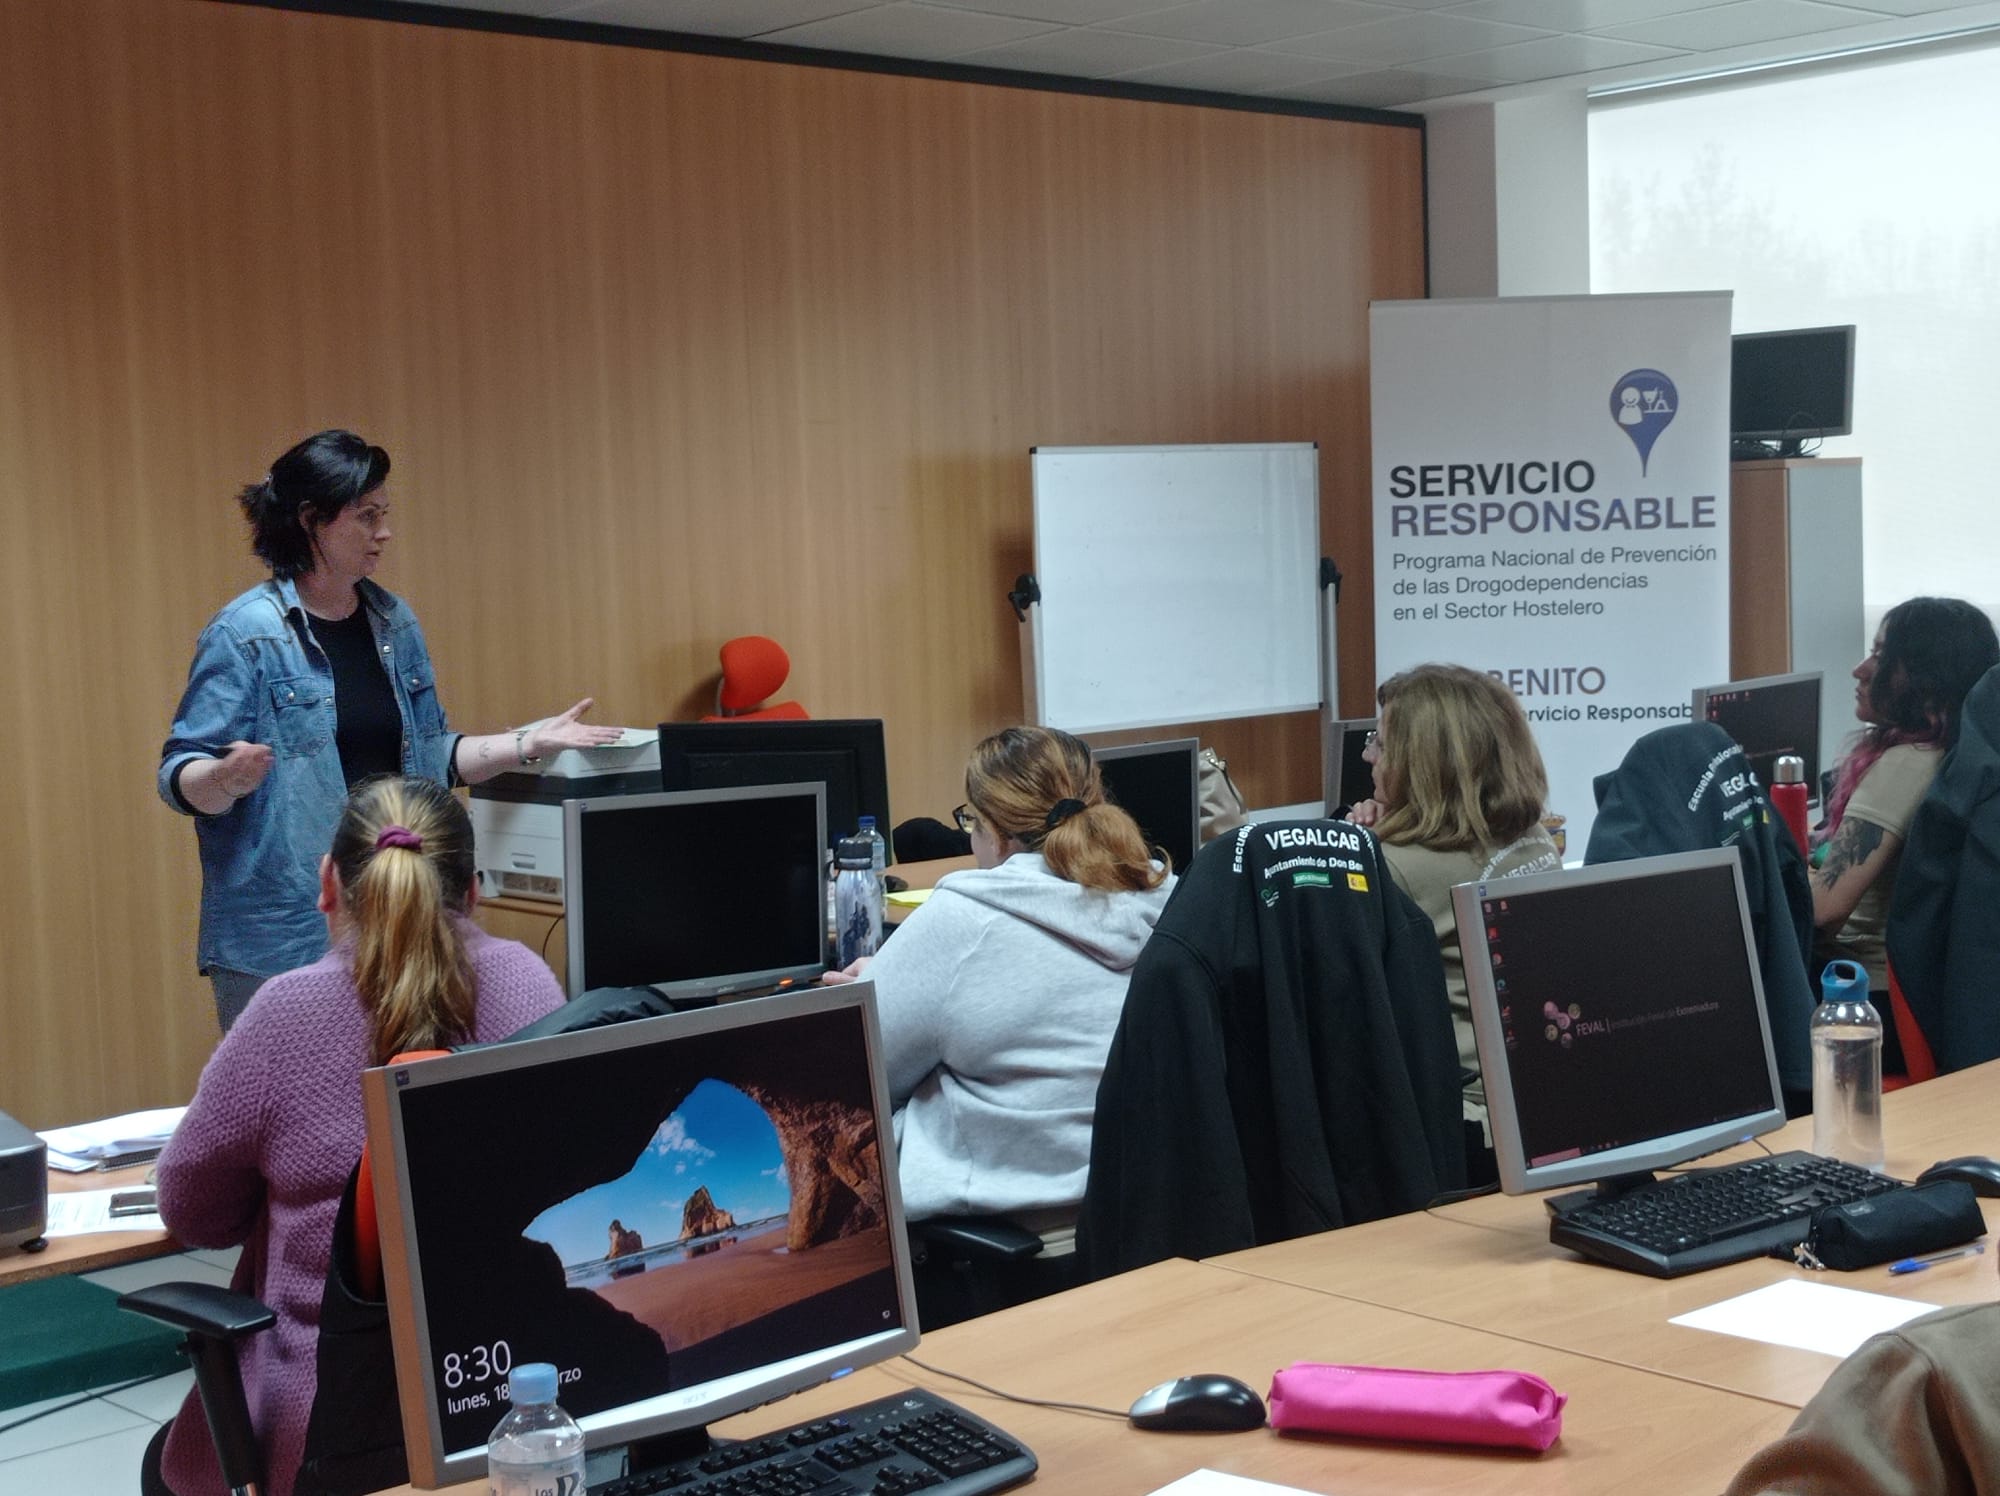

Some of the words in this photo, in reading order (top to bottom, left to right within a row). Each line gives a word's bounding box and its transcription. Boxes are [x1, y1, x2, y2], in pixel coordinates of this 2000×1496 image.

[1390, 460, 1595, 498] SERVICIO
[1391, 496, 1716, 537] RESPONSABLE
[1393, 551, 1485, 573] Programa
[1492, 548, 1574, 567] Nacional
[1581, 547, 1605, 564] de
[1611, 544, 1717, 564] Prevención
[1393, 578, 1417, 595] de
[1423, 577, 1449, 594] las
[1456, 572, 1648, 596] Drogodependencias
[1393, 606, 1416, 620] en
[1423, 603, 1438, 619] el
[1444, 602, 1507, 619] Sector
[1513, 599, 1604, 617] Hostelero
[1528, 704, 1580, 722] rvicio
[1586, 702, 1693, 722] Responsab
[1265, 828, 1361, 852] VEGALCAB
[1329, 857, 1347, 869] Don
[1576, 1021, 1606, 1037] FEVAL
[444, 1341, 511, 1388] 8:30
[447, 1392, 490, 1414] lunes,
[494, 1383, 510, 1401] 18
[559, 1367, 582, 1384] rzo
